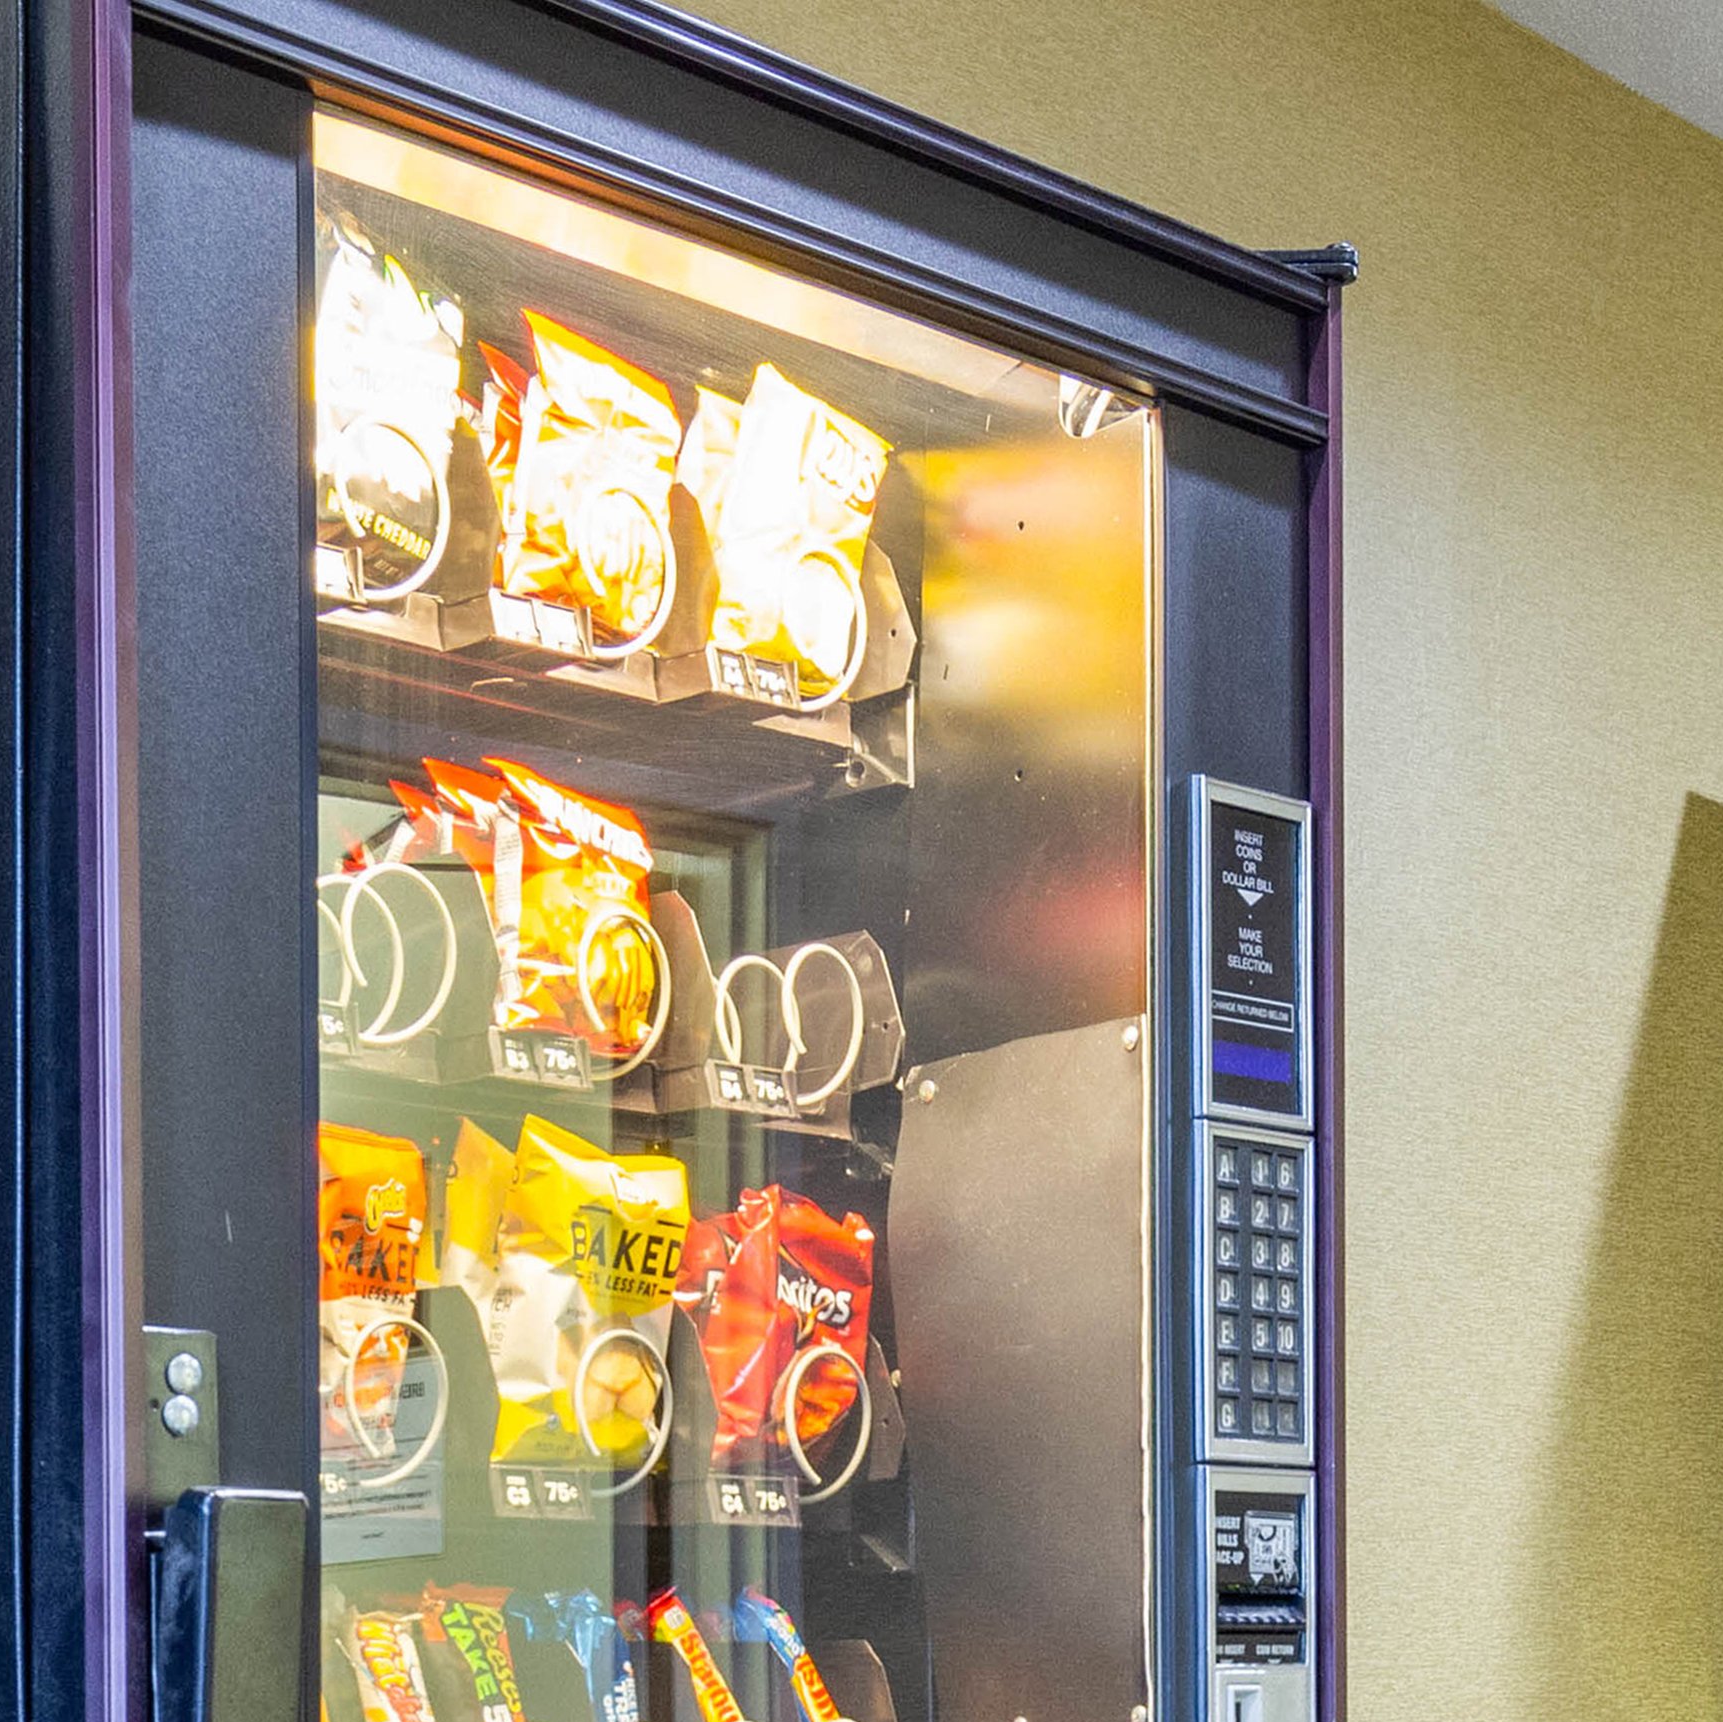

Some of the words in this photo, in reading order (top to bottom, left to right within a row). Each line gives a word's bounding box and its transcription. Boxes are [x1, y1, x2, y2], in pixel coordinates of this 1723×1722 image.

[1233, 828, 1265, 847] INSERT
[1235, 843, 1263, 862] COINS
[1242, 859, 1258, 876] OR
[1222, 869, 1256, 890] DOLLAR
[1256, 875, 1275, 894] BILL
[1238, 926, 1264, 943] MAKE
[1238, 941, 1264, 959] YOUR
[1227, 955, 1274, 975] SELECTION
[1218, 1155, 1230, 1180] A
[1256, 1159, 1266, 1183] 1
[1279, 1163, 1290, 1187] 6
[1219, 1196, 1231, 1219] B
[1254, 1201, 1266, 1225] 2
[1279, 1204, 1290, 1228] 7
[571, 1220, 684, 1280] BAKED
[1219, 1237, 1231, 1261] C
[1254, 1241, 1266, 1266] 3
[1279, 1245, 1290, 1269] 8
[604, 1275, 634, 1294] LESS
[636, 1279, 658, 1298] FAT
[1219, 1279, 1231, 1303] D
[1254, 1282, 1266, 1306] 4
[1280, 1285, 1291, 1309] 9
[1220, 1322, 1231, 1346] E
[1254, 1323, 1266, 1348] 5
[1277, 1326, 1294, 1351] 10
[1220, 1363, 1231, 1387] F
[1220, 1404, 1232, 1429] G
[441, 1602, 499, 1701] TAKE
